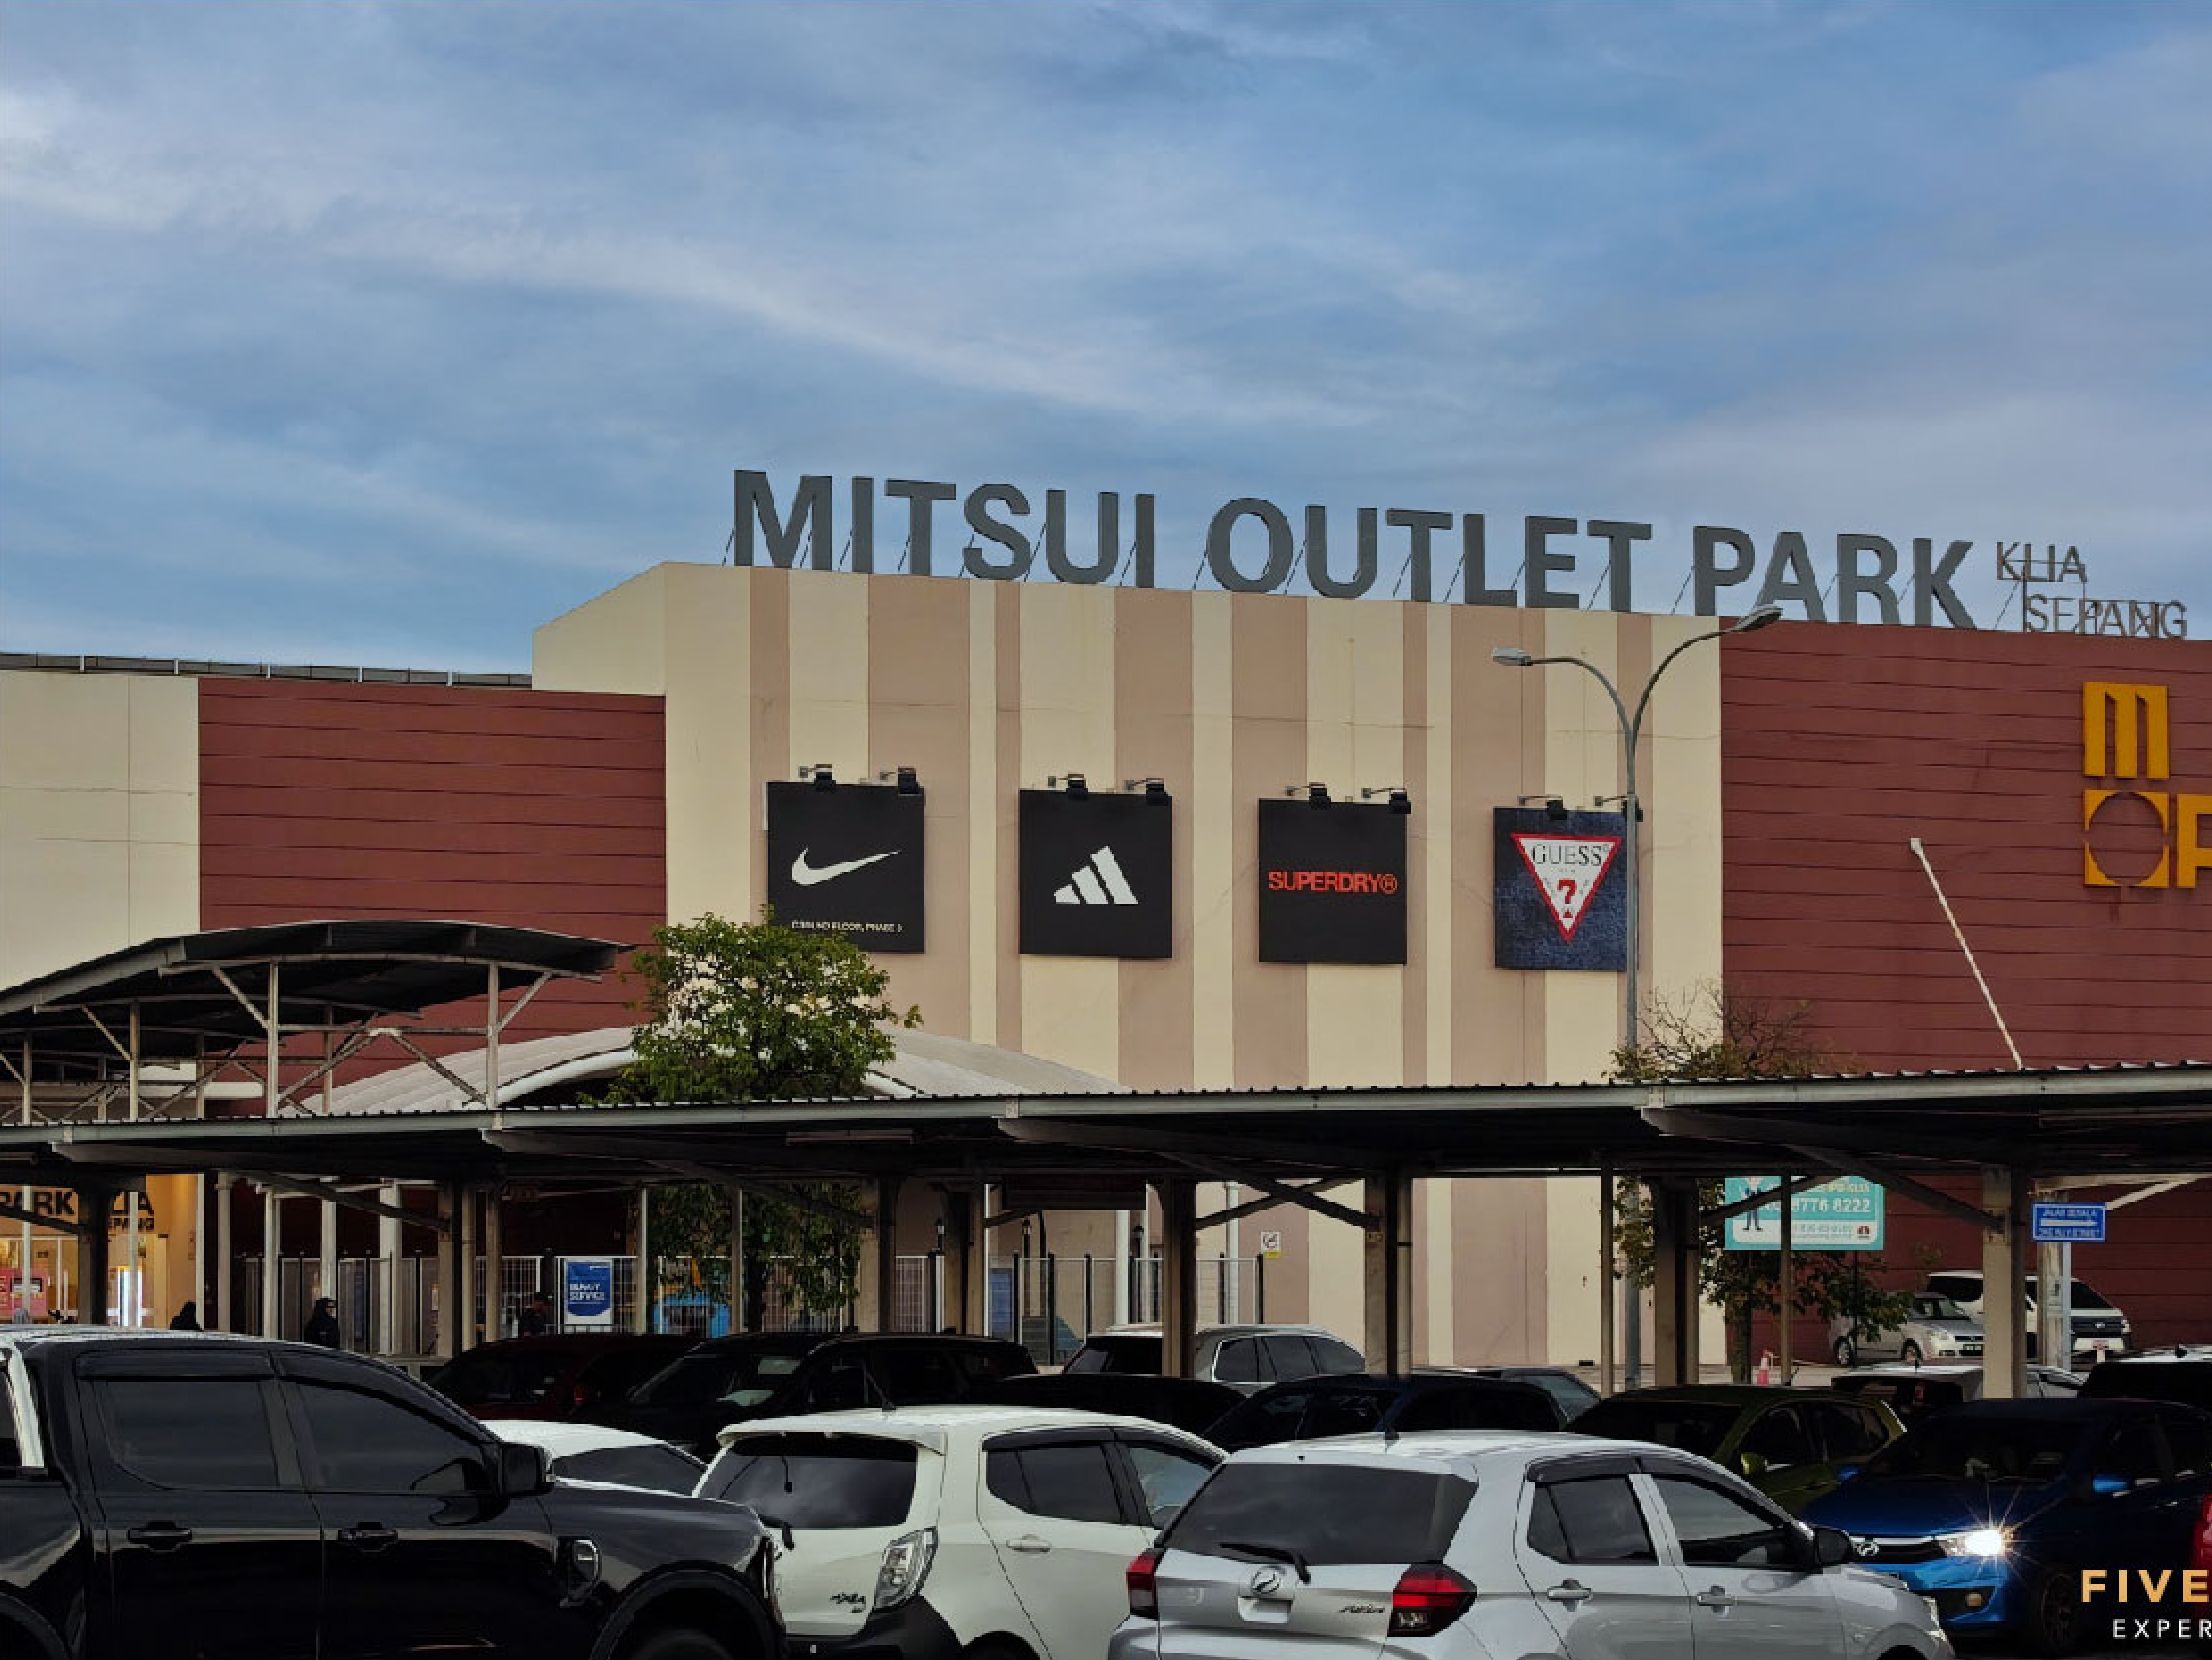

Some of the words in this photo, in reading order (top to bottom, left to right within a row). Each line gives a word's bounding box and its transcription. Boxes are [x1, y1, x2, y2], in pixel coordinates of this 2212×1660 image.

[734, 470, 1154, 588] MITSUI
[1207, 498, 1653, 612] OUTLET
[1693, 526, 1978, 629] PARK
[1997, 541, 2087, 582] KLIA
[2026, 594, 2187, 639] SEPANG
